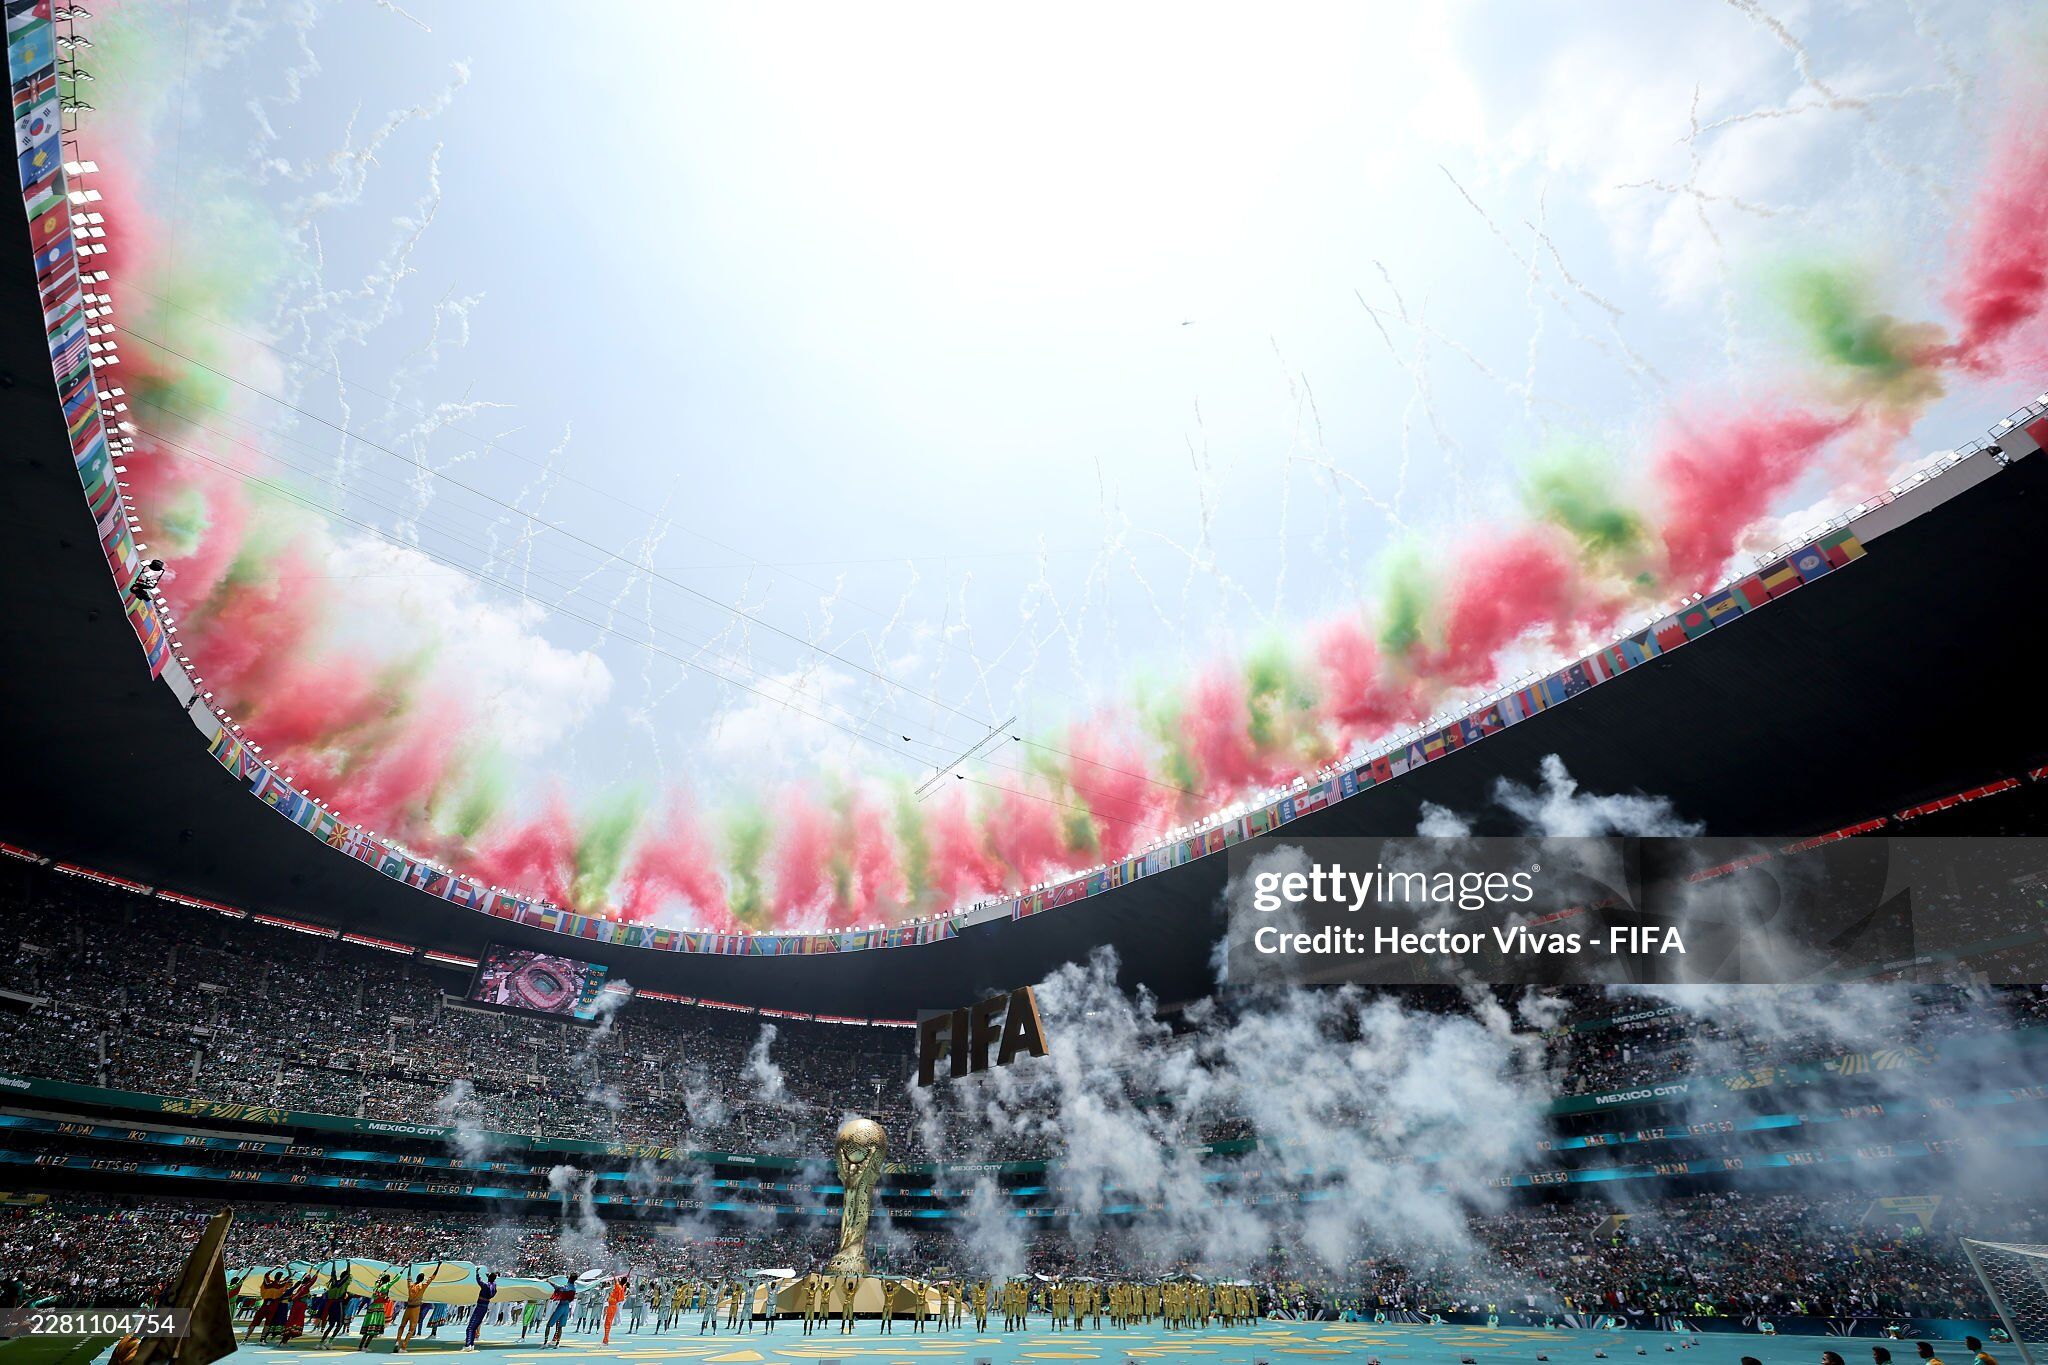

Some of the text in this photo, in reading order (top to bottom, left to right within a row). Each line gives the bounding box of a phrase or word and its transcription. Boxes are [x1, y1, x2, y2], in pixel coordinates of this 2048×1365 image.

[1343, 774, 1354, 794] FIFA
[1283, 800, 1292, 820] FIFA
[1612, 1004, 1683, 1025] MEXICO CITY
[917, 985, 1049, 1087] FIFA
[1595, 1084, 1689, 1105] MEXICO CITY
[368, 1122, 445, 1136] MEXICO CITY
[1688, 1120, 1734, 1136] LET'S GO
[128, 1131, 147, 1141] IKO
[1637, 1128, 1665, 1142] ALLEZ
[1584, 1134, 1606, 1148] DALE
[237, 1142, 266, 1152] ALLEZ
[284, 1145, 324, 1157] LET'S GO
[33, 1155, 69, 1167] ALLEZ
[90, 1159, 139, 1173] LET'S GO
[450, 1160, 464, 1168] IKO
[1723, 1158, 1744, 1169] IKO
[229, 1170, 262, 1181] DAI DAI
[530, 1166, 550, 1175] ALLEZ
[290, 1175, 307, 1184] IKO
[340, 1178, 358, 1188] DALE
[1529, 1172, 1568, 1185] LET'S GO
[384, 1182, 410, 1192] ALLEZ
[426, 1185, 460, 1195] LET'S GO
[758, 1182, 775, 1191] ALLEZ
[644, 1198, 664, 1207] ALLEZ
[676, 1200, 694, 1209] LET'S
